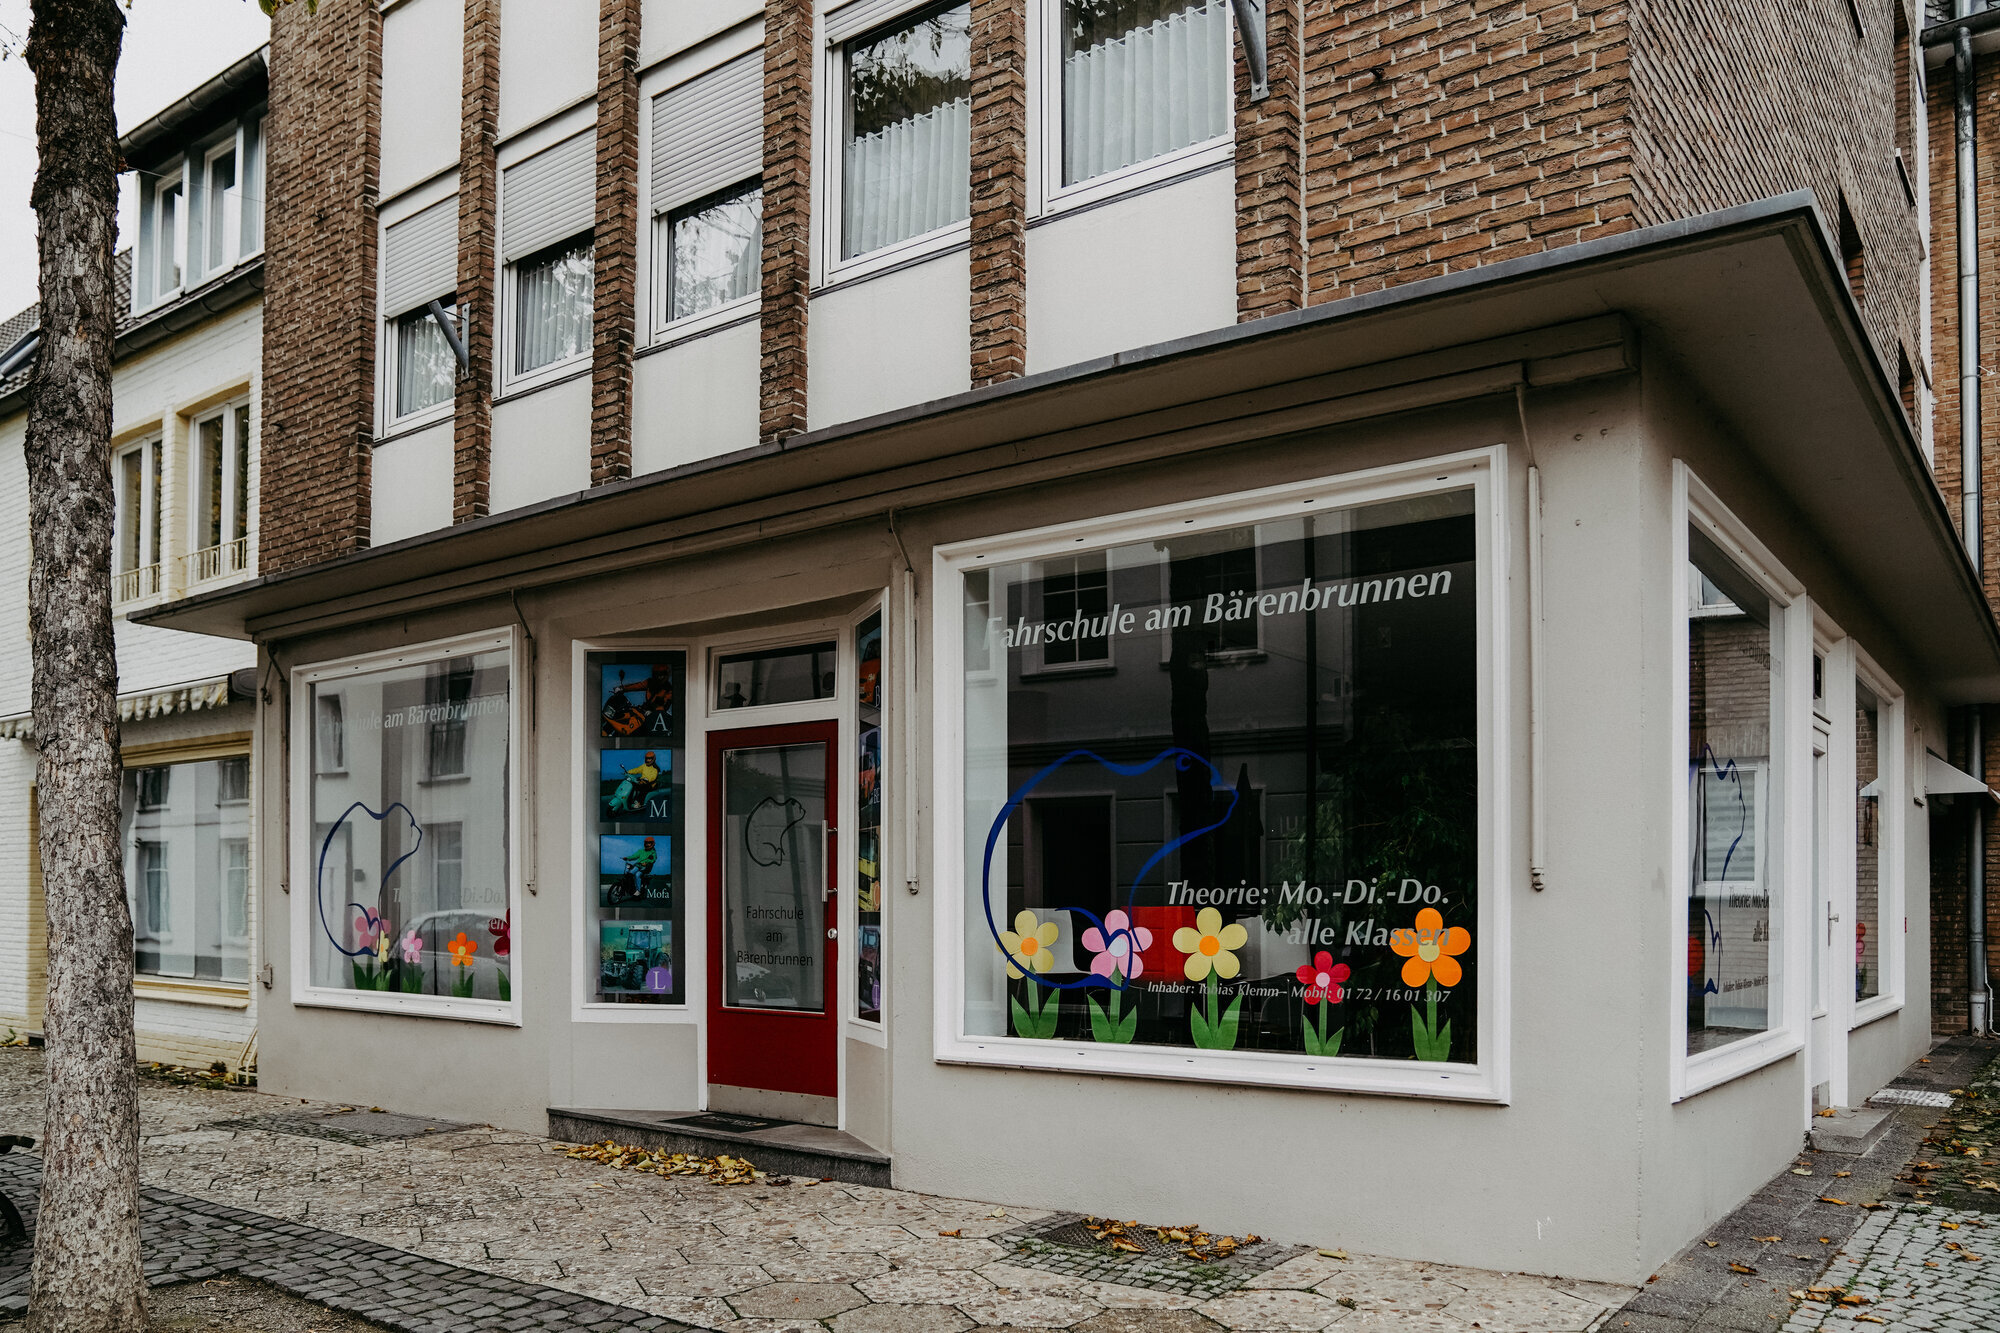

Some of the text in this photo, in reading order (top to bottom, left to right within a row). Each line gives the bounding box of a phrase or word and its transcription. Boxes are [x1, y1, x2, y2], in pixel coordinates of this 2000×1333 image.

[983, 570, 1453, 650] Fahrschule am Bärenbrunnen
[384, 712, 404, 729] am
[407, 698, 505, 726] Bärenbrunnen
[651, 712, 669, 732] A
[649, 799, 668, 818] M
[646, 888, 670, 899] Mofa
[1167, 877, 1450, 906] Theorie: Mo.-Di.-Do.
[746, 905, 804, 920] Fahrschule
[766, 930, 783, 943] am
[1286, 918, 1451, 947] alle Klassen
[736, 950, 813, 966] Bärenbrunnen
[653, 970, 667, 990] L
[1147, 981, 1195, 995] Inhaber:
[1291, 986, 1332, 999] Mobil:
[1336, 988, 1351, 1000] 01
[1356, 988, 1373, 1001] 72
[1385, 989, 1401, 1001] 16
[1404, 989, 1420, 1002] 01
[1424, 990, 1452, 1003] 307
